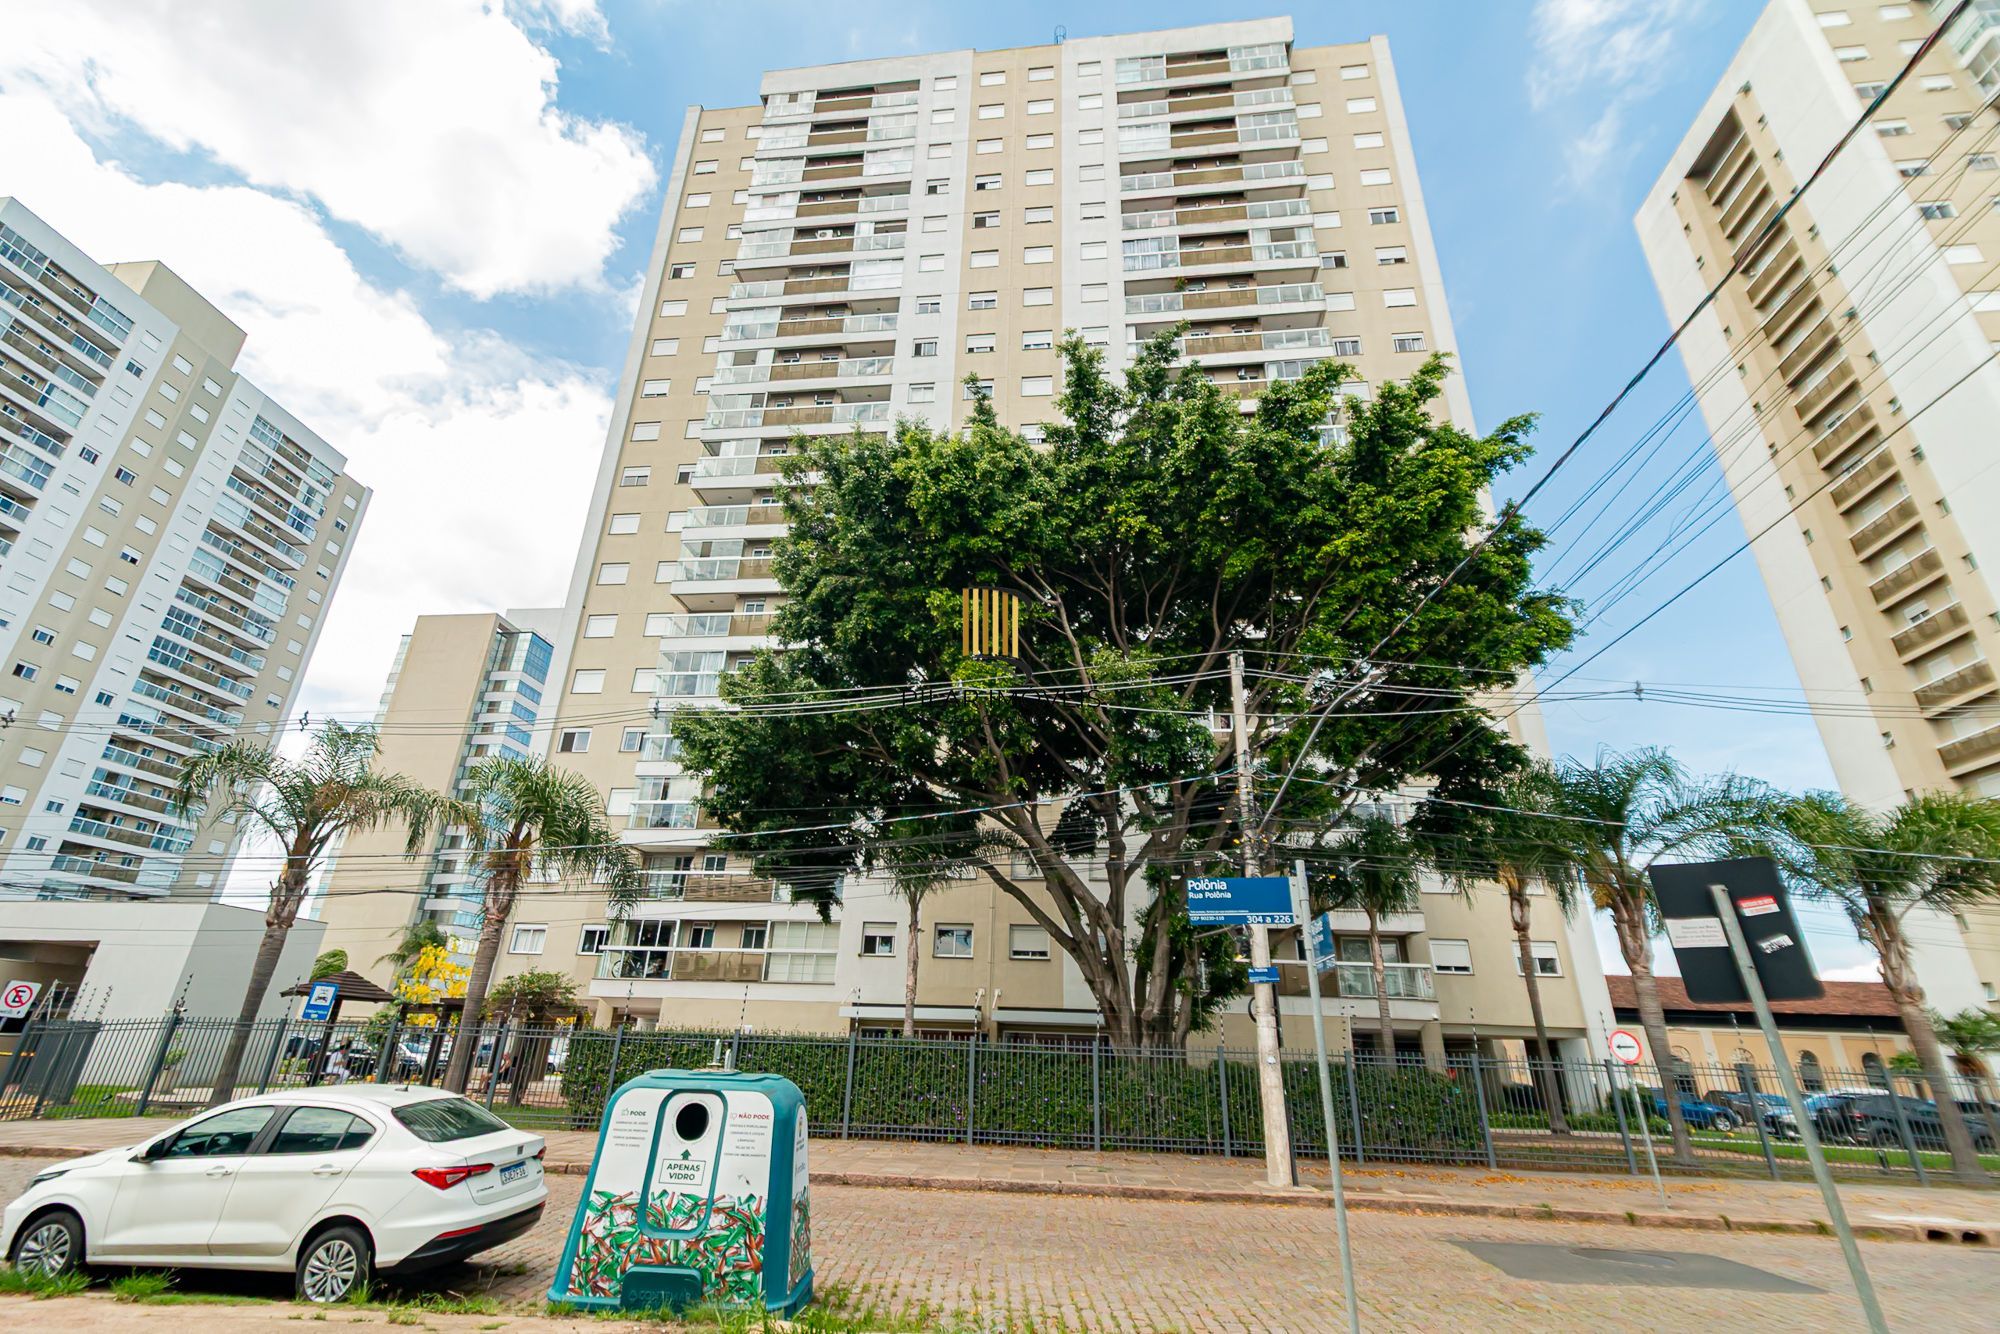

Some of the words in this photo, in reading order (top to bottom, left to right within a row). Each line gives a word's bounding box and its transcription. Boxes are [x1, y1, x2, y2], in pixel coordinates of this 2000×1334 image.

[1187, 879, 1227, 891] Polônia
[1205, 891, 1232, 899] Polônia
[1247, 915, 1263, 924] 304
[1274, 915, 1291, 923] 226
[666, 1163, 701, 1173] APENAS
[668, 1172, 696, 1181] VIDRO
